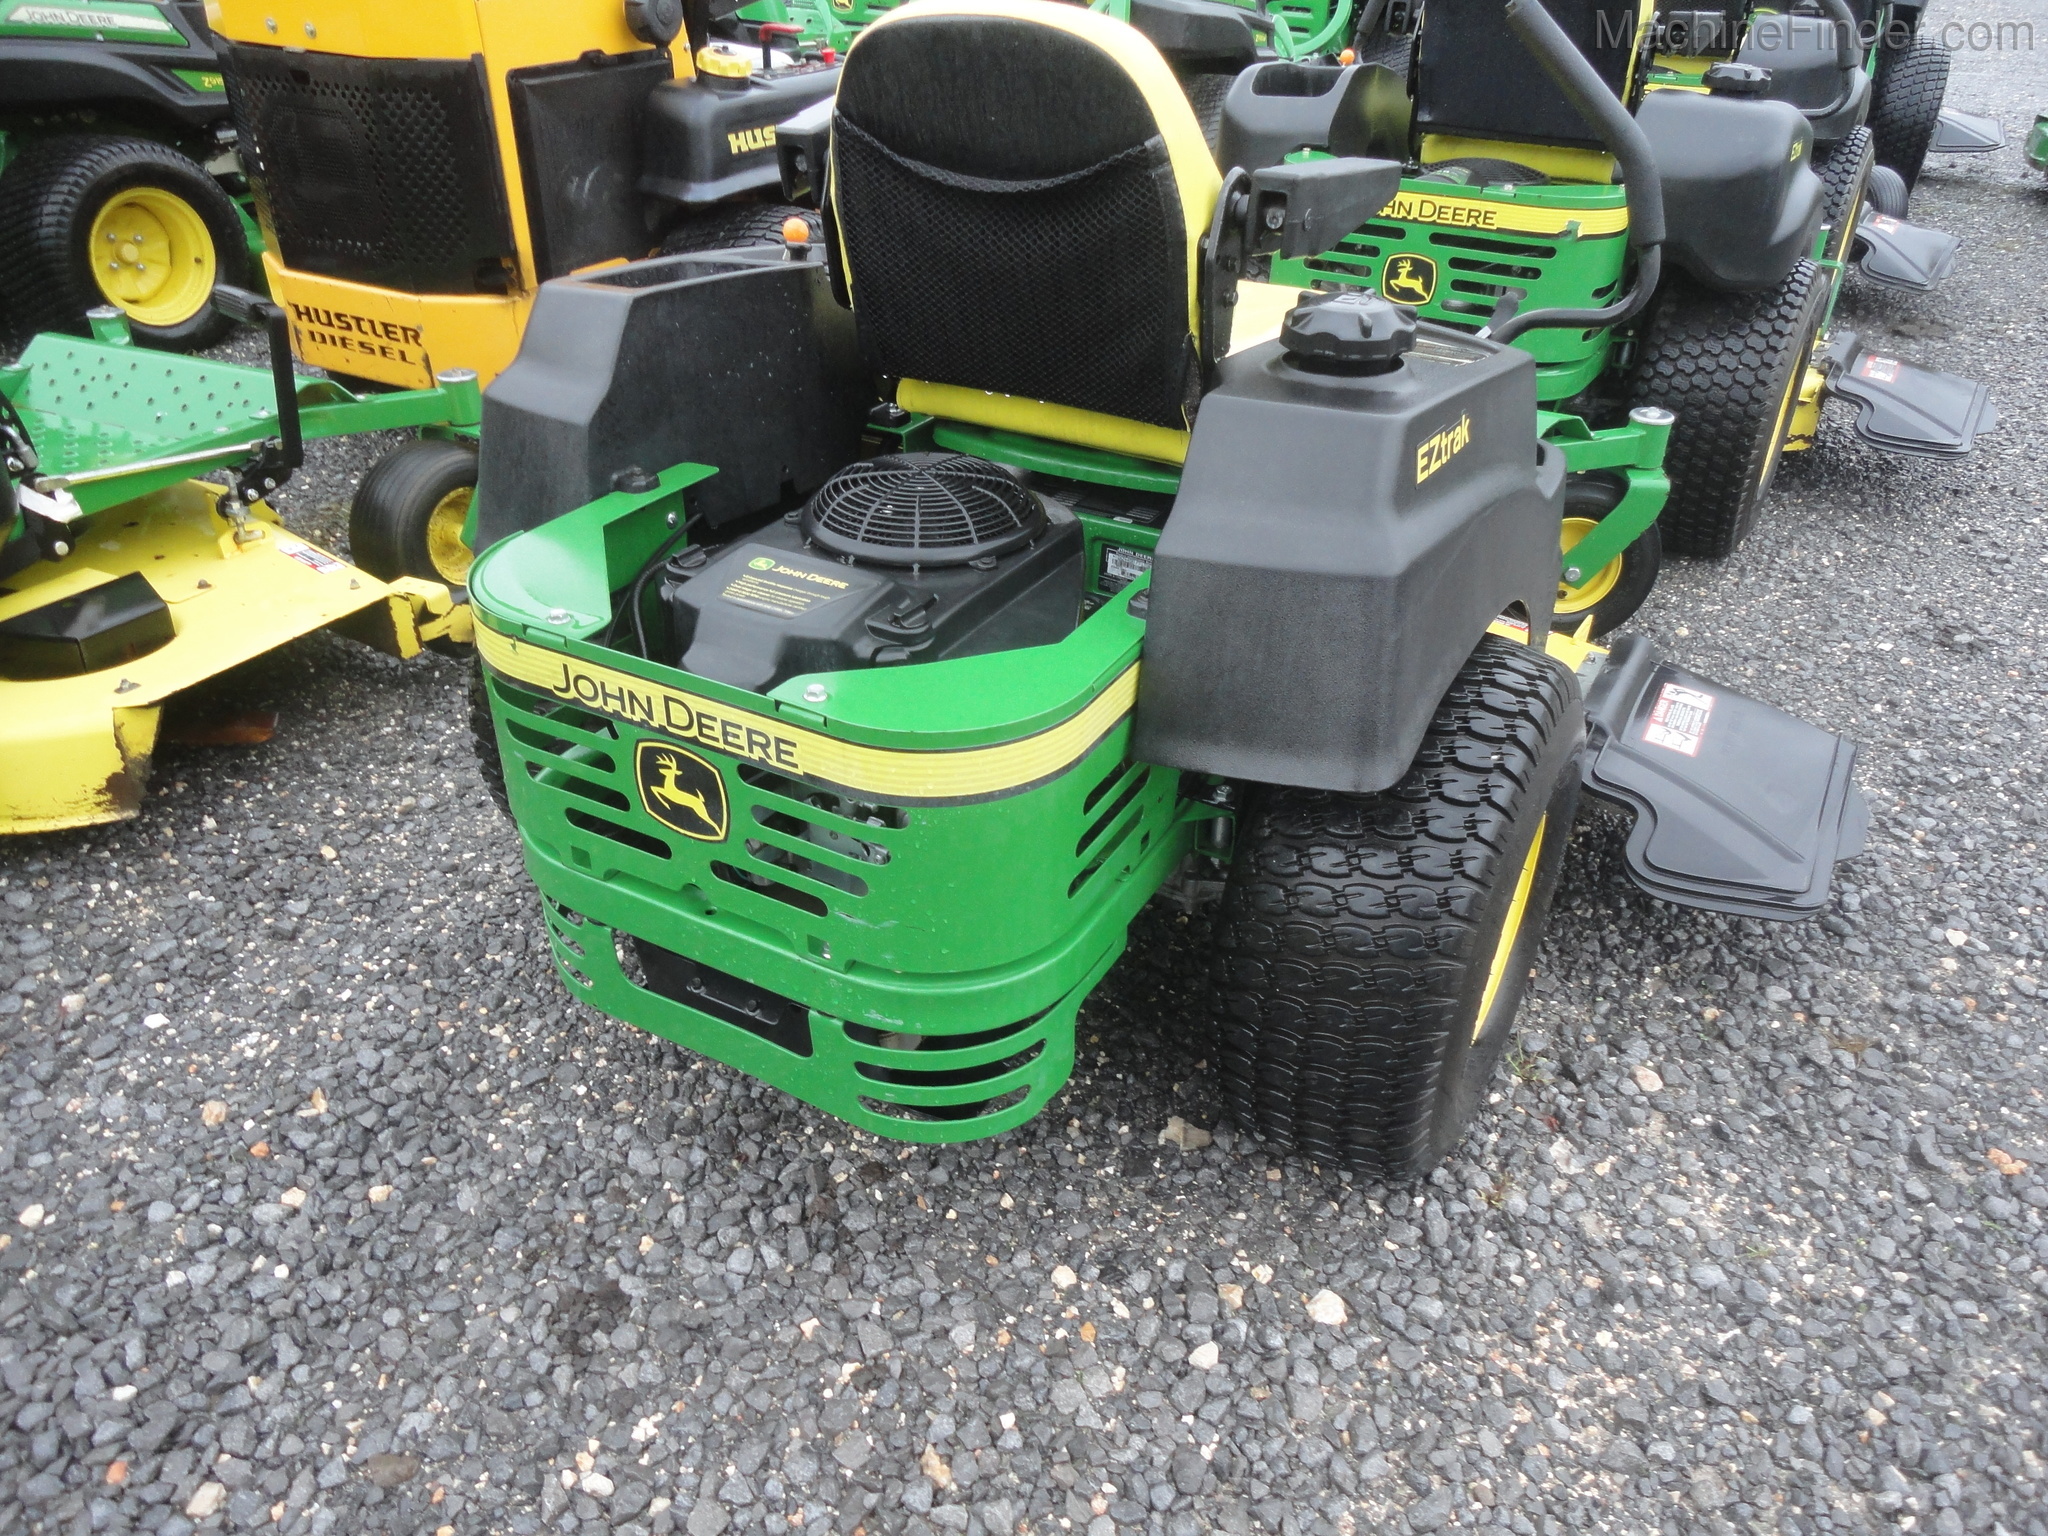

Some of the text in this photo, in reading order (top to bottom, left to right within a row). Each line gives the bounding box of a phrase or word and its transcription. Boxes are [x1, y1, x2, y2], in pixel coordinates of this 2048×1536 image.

[25, 8, 65, 23] JOHN
[1420, 199, 1498, 227] DEERE
[288, 301, 422, 347] HUSTLER
[307, 329, 416, 366] DIESEL
[1416, 413, 1471, 485] EZtrak
[771, 565, 808, 580] JOHN
[806, 573, 850, 590] DEERE
[552, 662, 800, 770] JOHN DEERE
